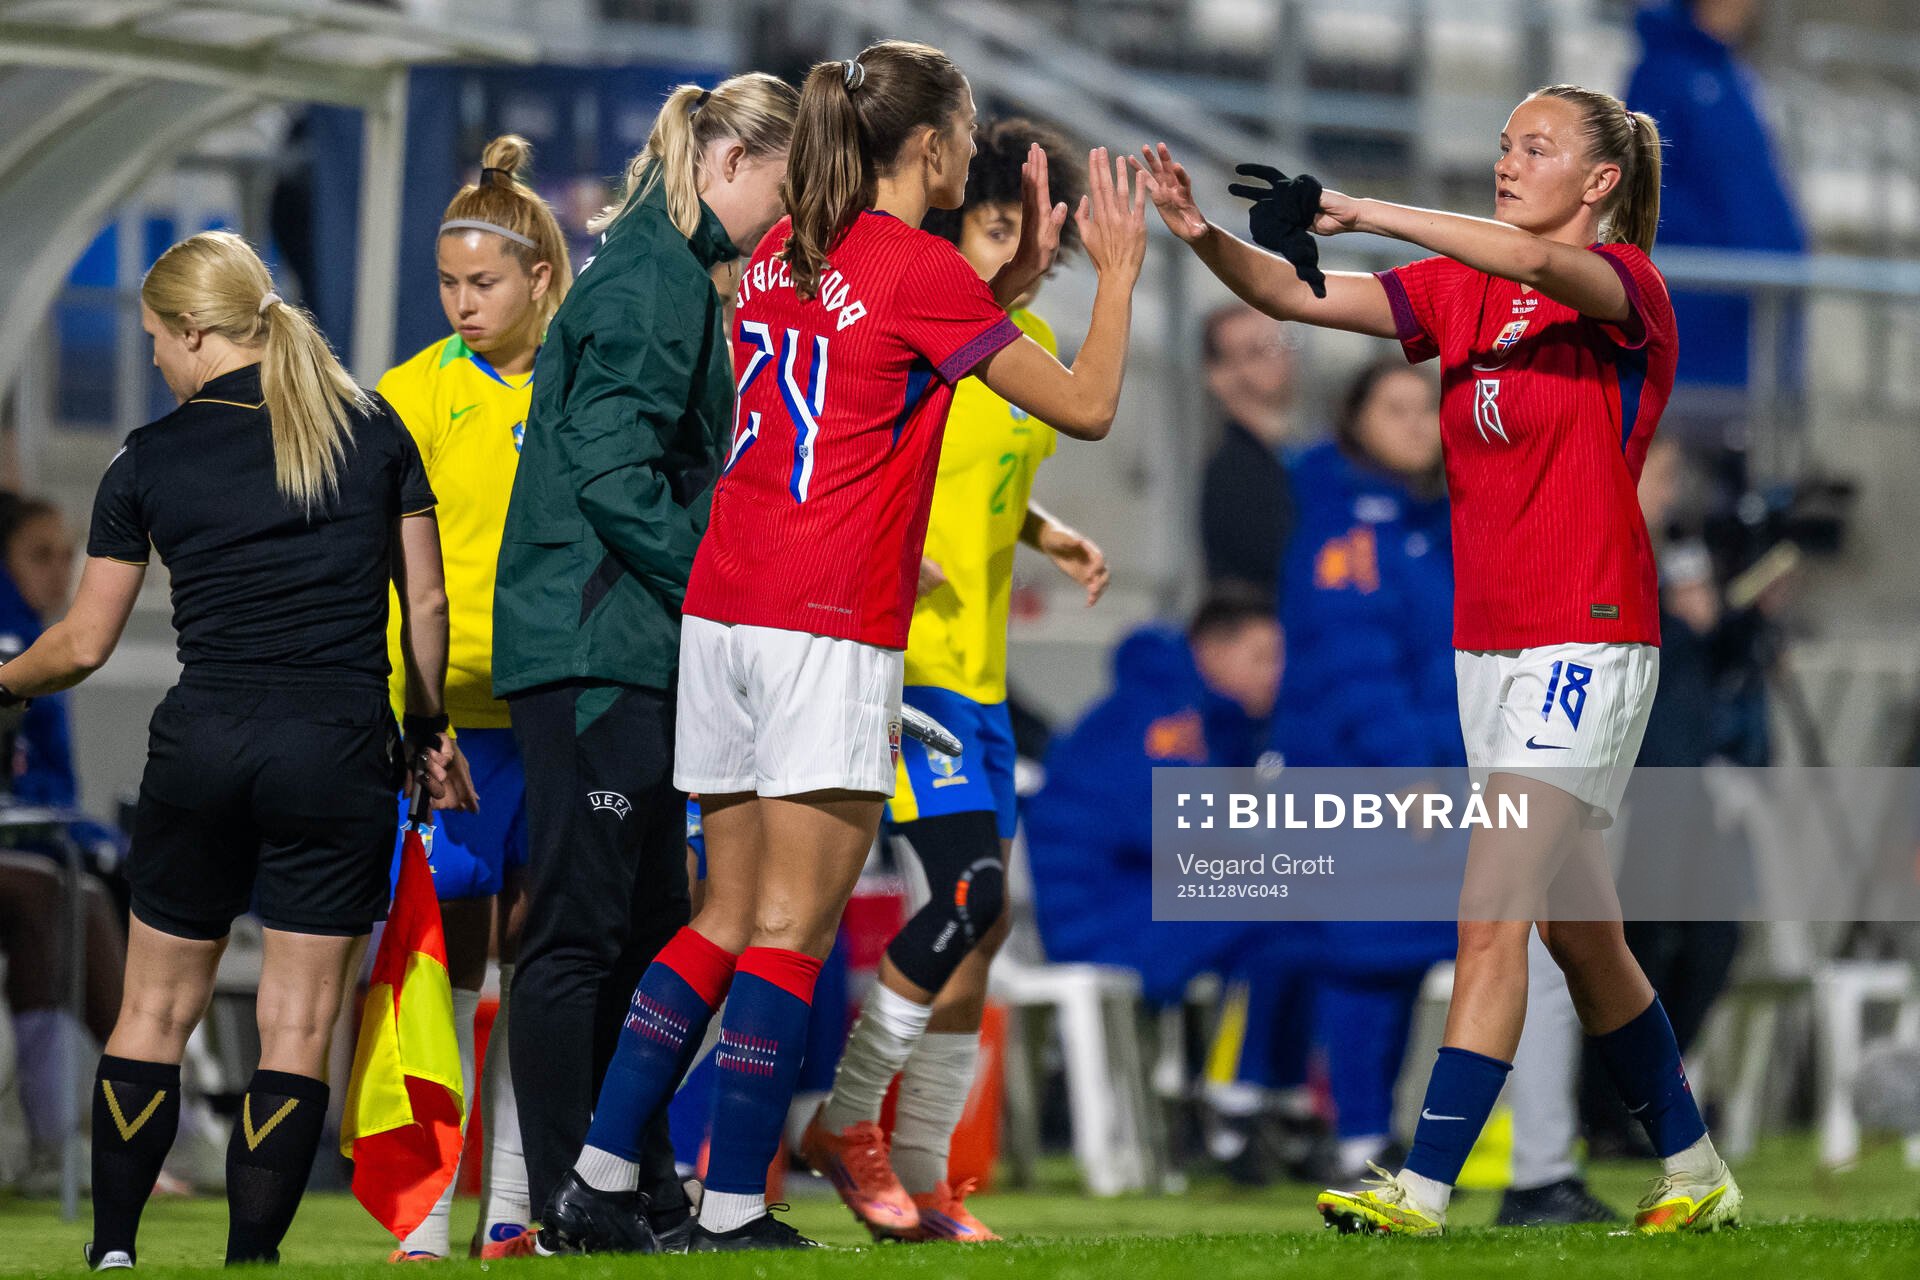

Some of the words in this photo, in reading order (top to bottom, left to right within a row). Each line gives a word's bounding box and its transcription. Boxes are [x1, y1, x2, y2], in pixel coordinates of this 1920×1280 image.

[722, 320, 829, 504] 24
[1473, 379, 1510, 445] 18
[1540, 660, 1593, 733] 18
[590, 795, 630, 817] UEFA
